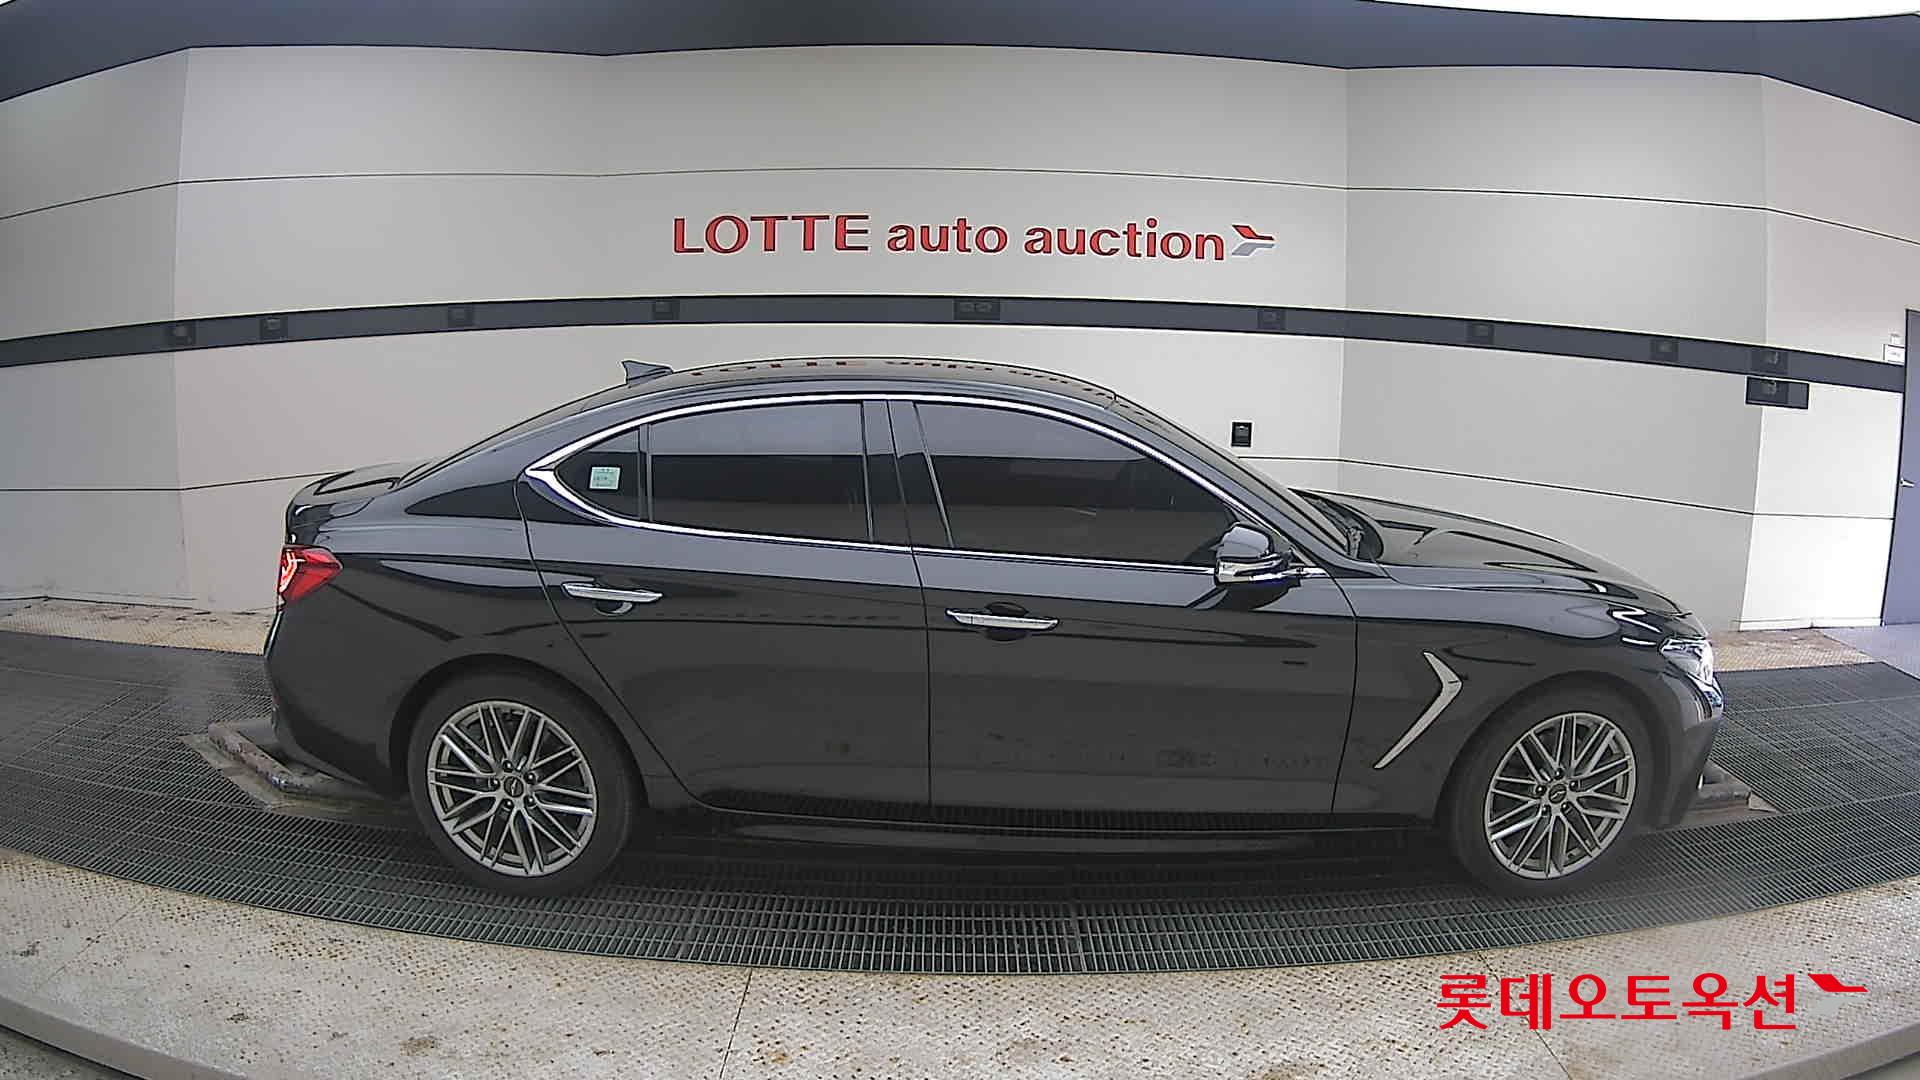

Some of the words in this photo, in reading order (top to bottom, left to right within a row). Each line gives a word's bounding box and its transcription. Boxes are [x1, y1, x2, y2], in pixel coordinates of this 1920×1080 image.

[673, 214, 870, 254] LOTTE
[886, 217, 1009, 255] auto
[1023, 217, 1226, 261] auction
